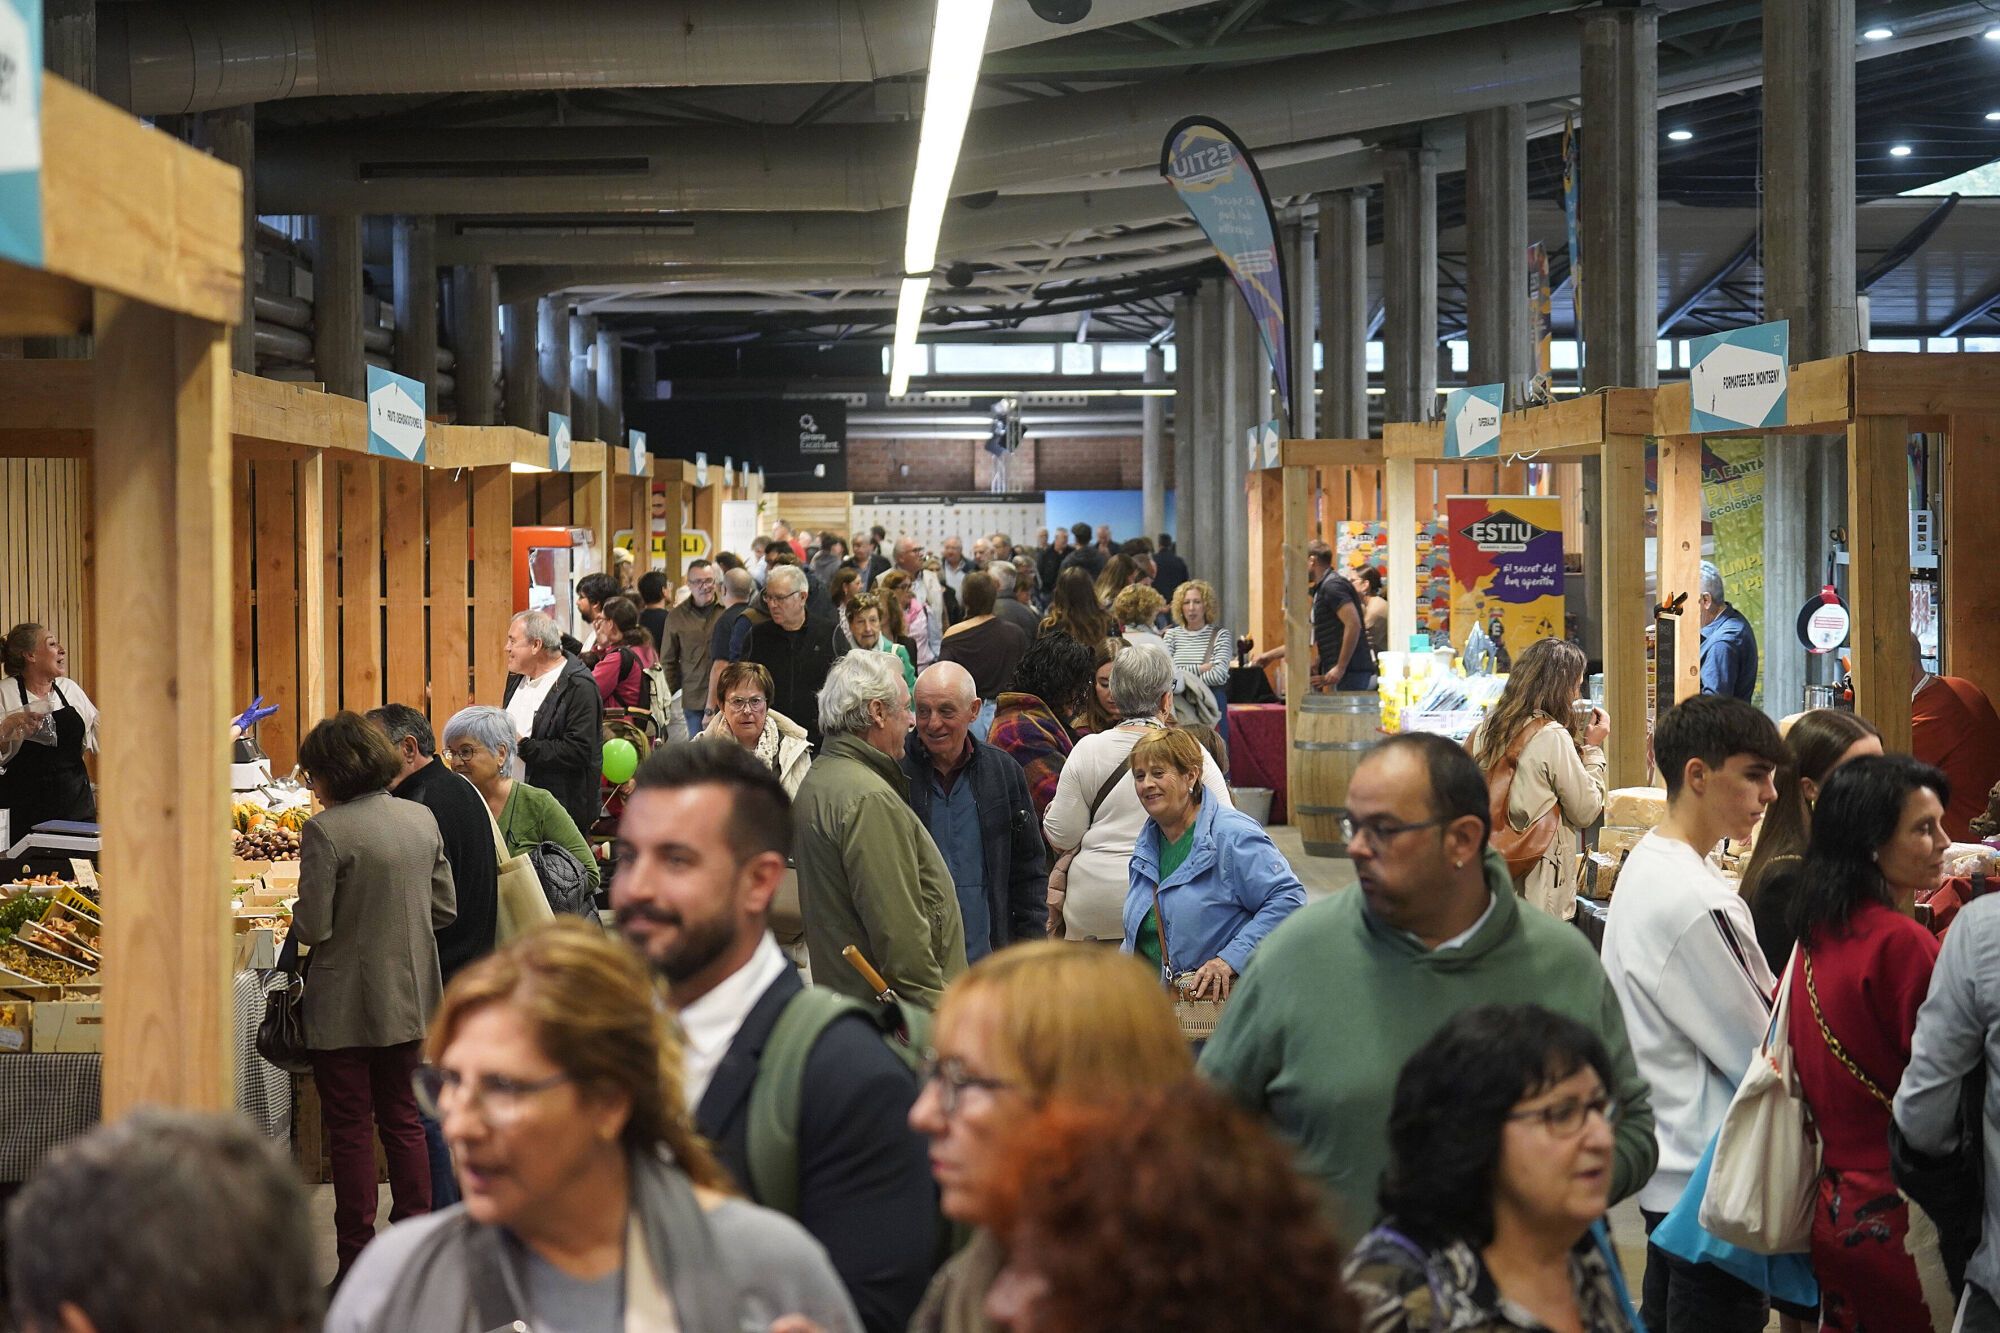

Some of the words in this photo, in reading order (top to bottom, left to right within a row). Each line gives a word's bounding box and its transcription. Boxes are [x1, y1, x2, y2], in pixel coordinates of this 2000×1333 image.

[1723, 374, 1747, 389] FORMATGES
[1747, 372, 1756, 387] DEL
[1756, 369, 1780, 386] MONTSENY
[1472, 523, 1532, 541] ESTIU
[1503, 563, 1512, 573] El
[1513, 563, 1541, 575] secret
[1543, 563, 1557, 573] del
